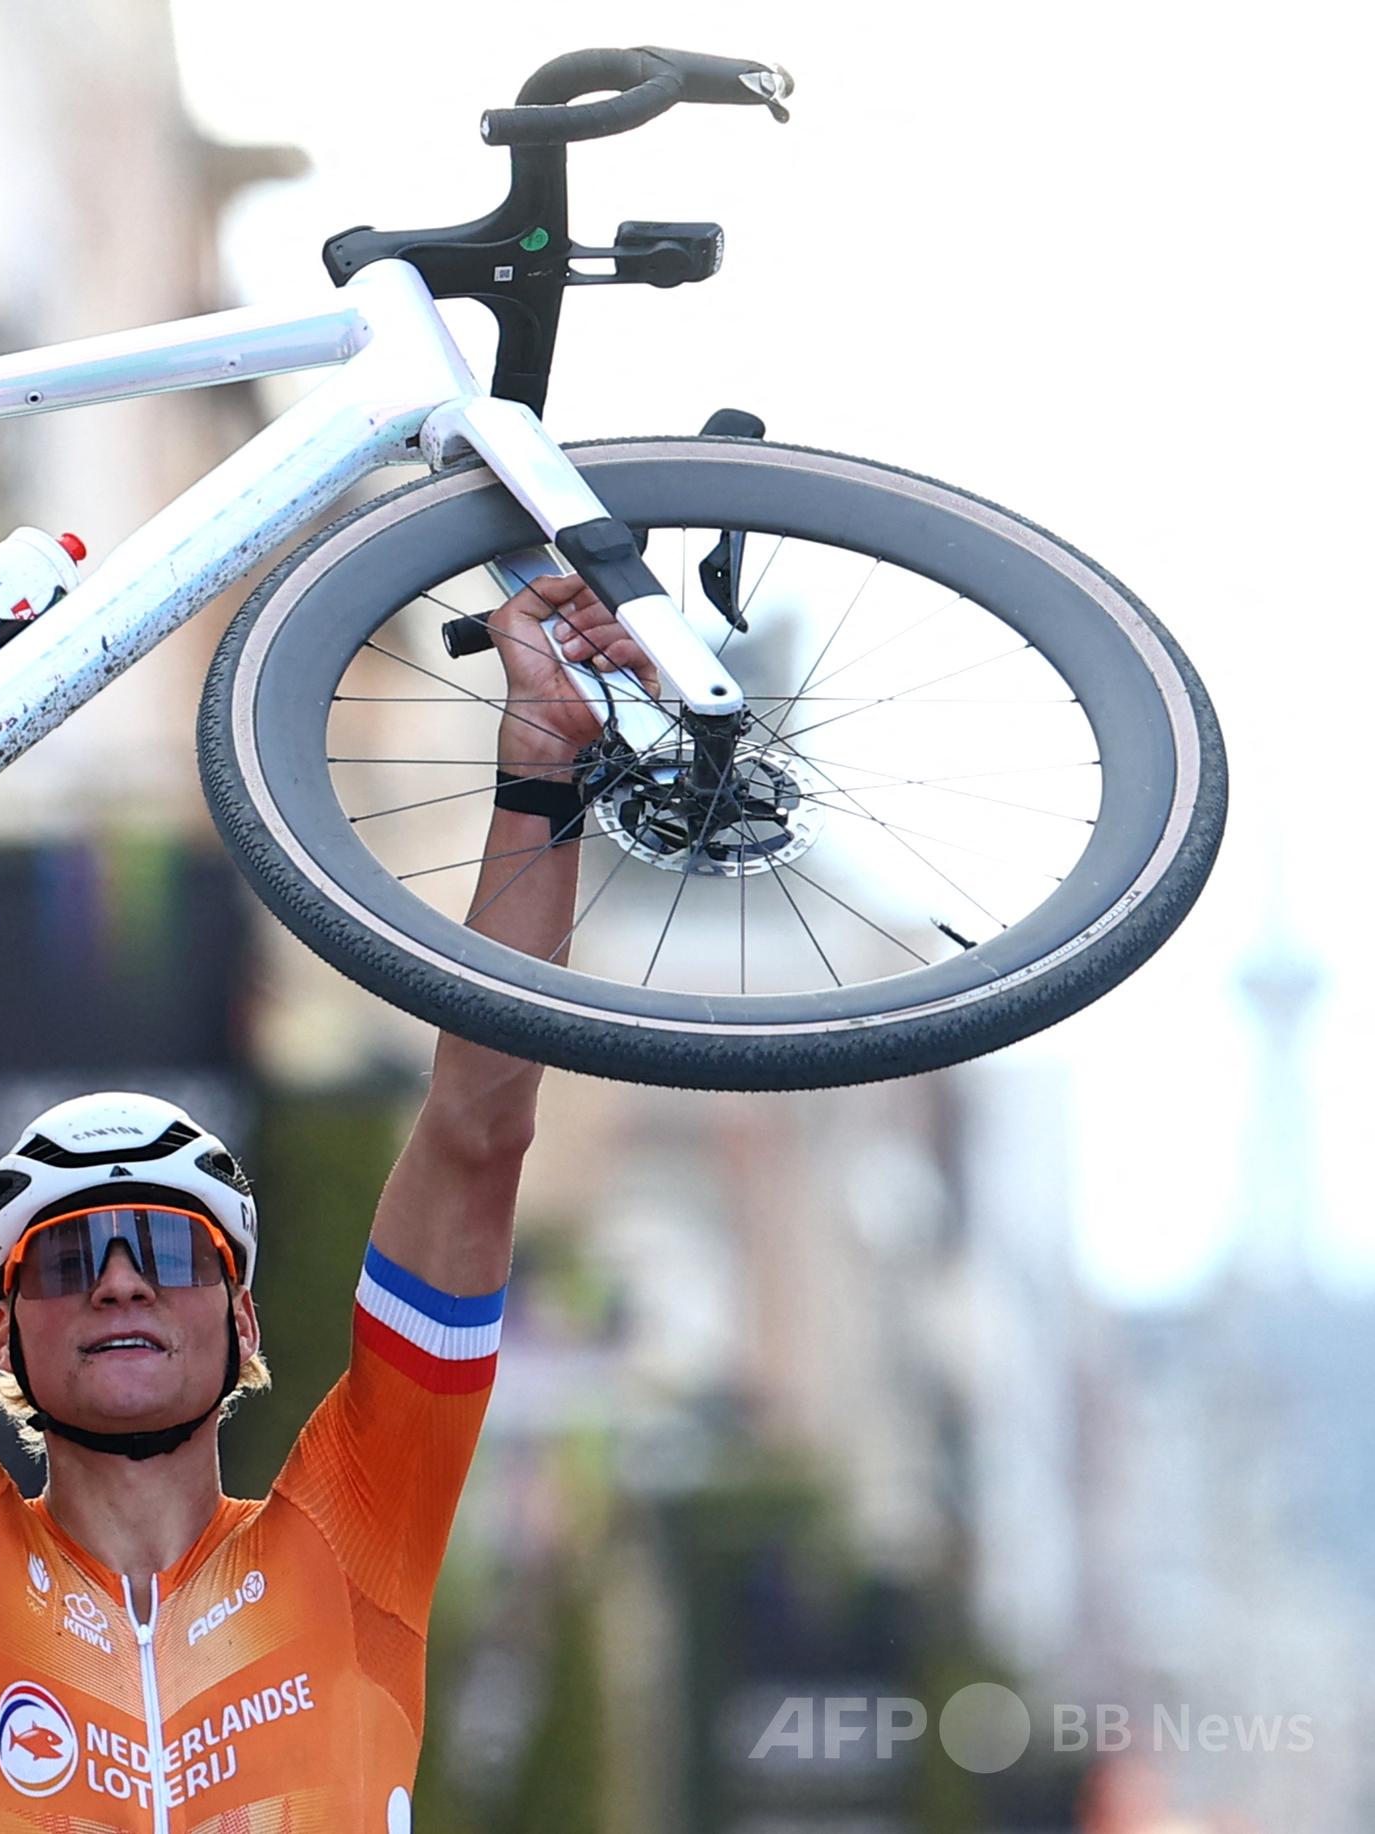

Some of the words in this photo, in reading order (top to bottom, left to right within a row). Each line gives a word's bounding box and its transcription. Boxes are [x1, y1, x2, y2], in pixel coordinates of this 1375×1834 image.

[71, 1125, 144, 1141] CANYON
[187, 1588, 244, 1647] AGU
[86, 1673, 315, 1774] NEDERLANDSE
[86, 1744, 238, 1809] LOTERIJ
